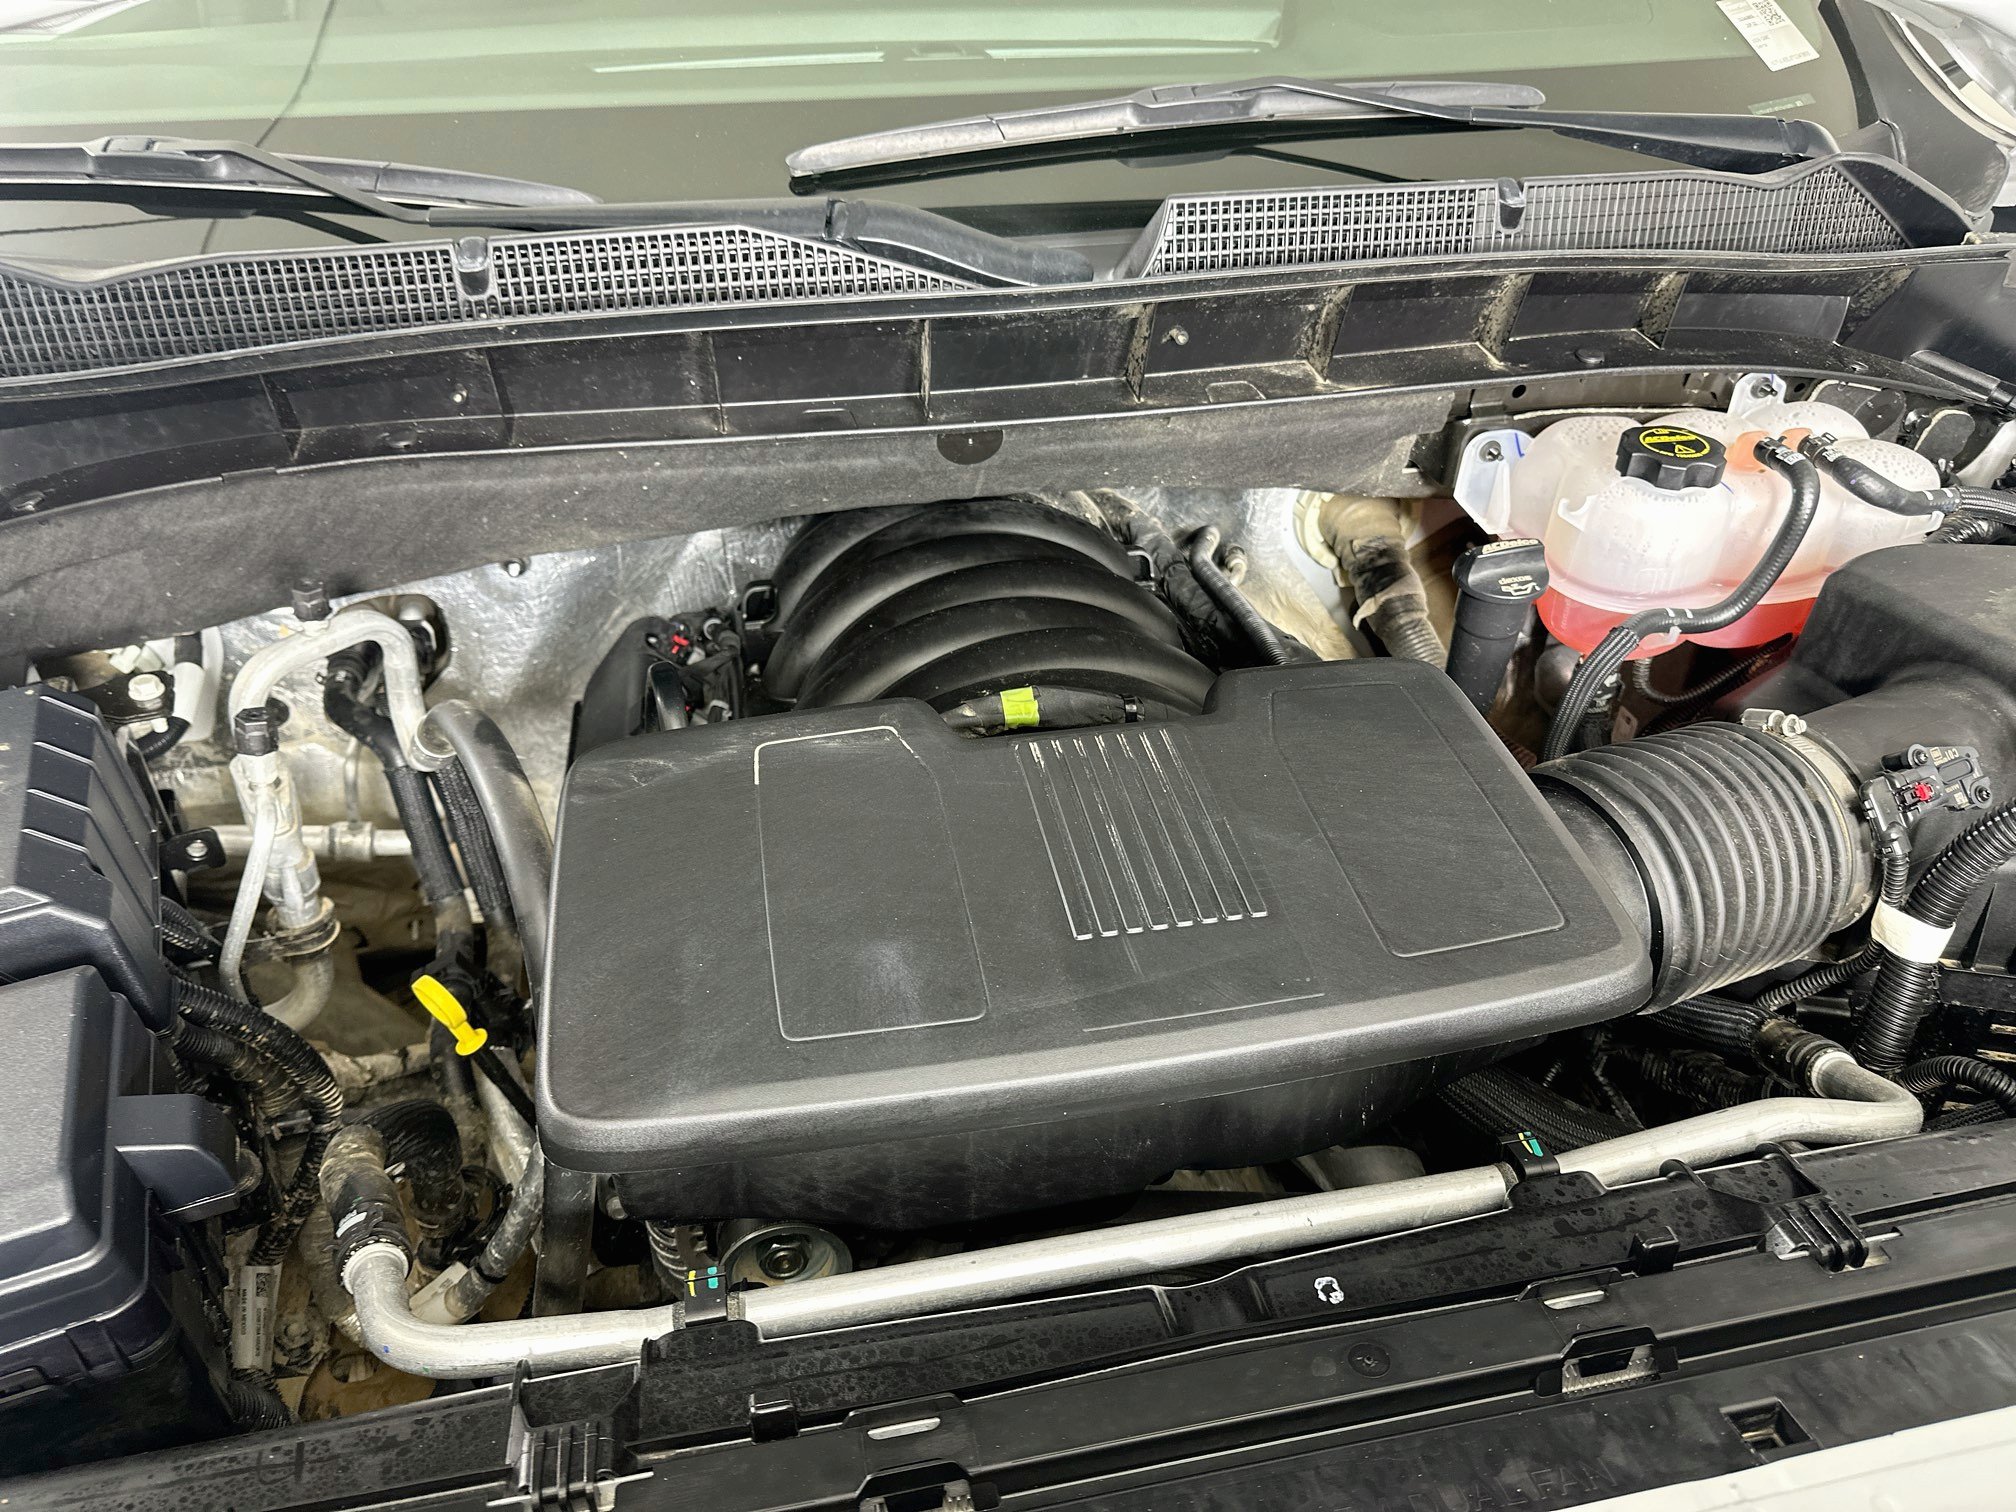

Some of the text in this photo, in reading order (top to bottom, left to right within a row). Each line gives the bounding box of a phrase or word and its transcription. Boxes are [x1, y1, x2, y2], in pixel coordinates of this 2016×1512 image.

[1482, 538, 1539, 555] ACDelco
[1498, 575, 1533, 585] dexos
[1530, 1457, 1619, 1501] FAN
